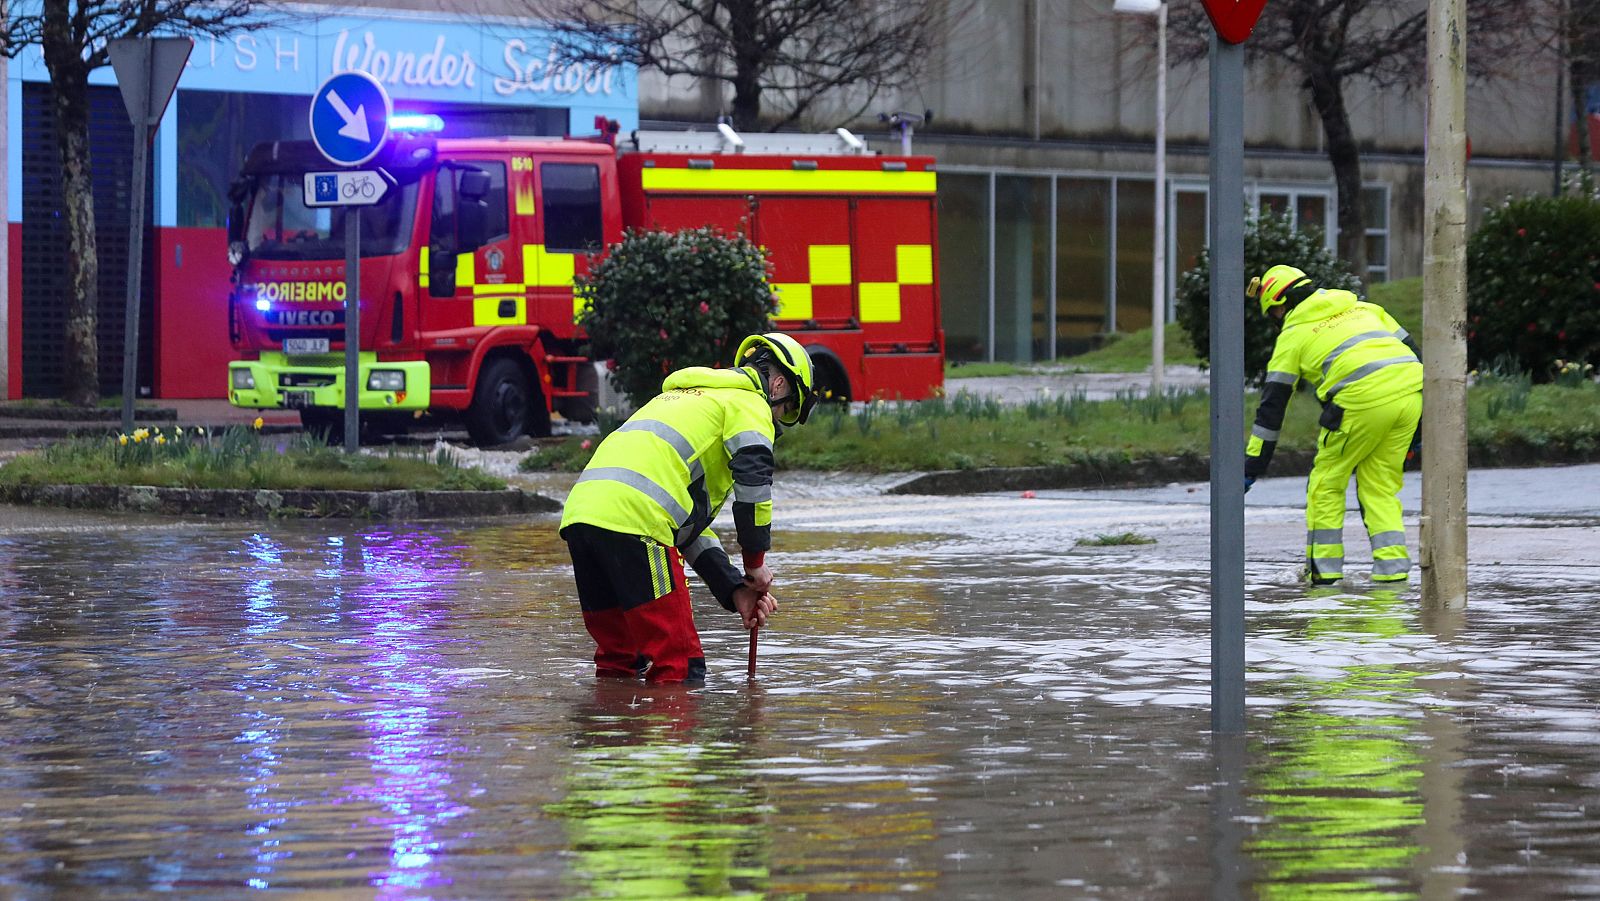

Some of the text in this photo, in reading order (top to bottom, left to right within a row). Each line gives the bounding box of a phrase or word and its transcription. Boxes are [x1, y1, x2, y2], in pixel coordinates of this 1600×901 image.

[332, 29, 475, 88] Wonder
[494, 38, 614, 95] School
[321, 181, 329, 193] 3
[279, 310, 335, 325] IVECO
